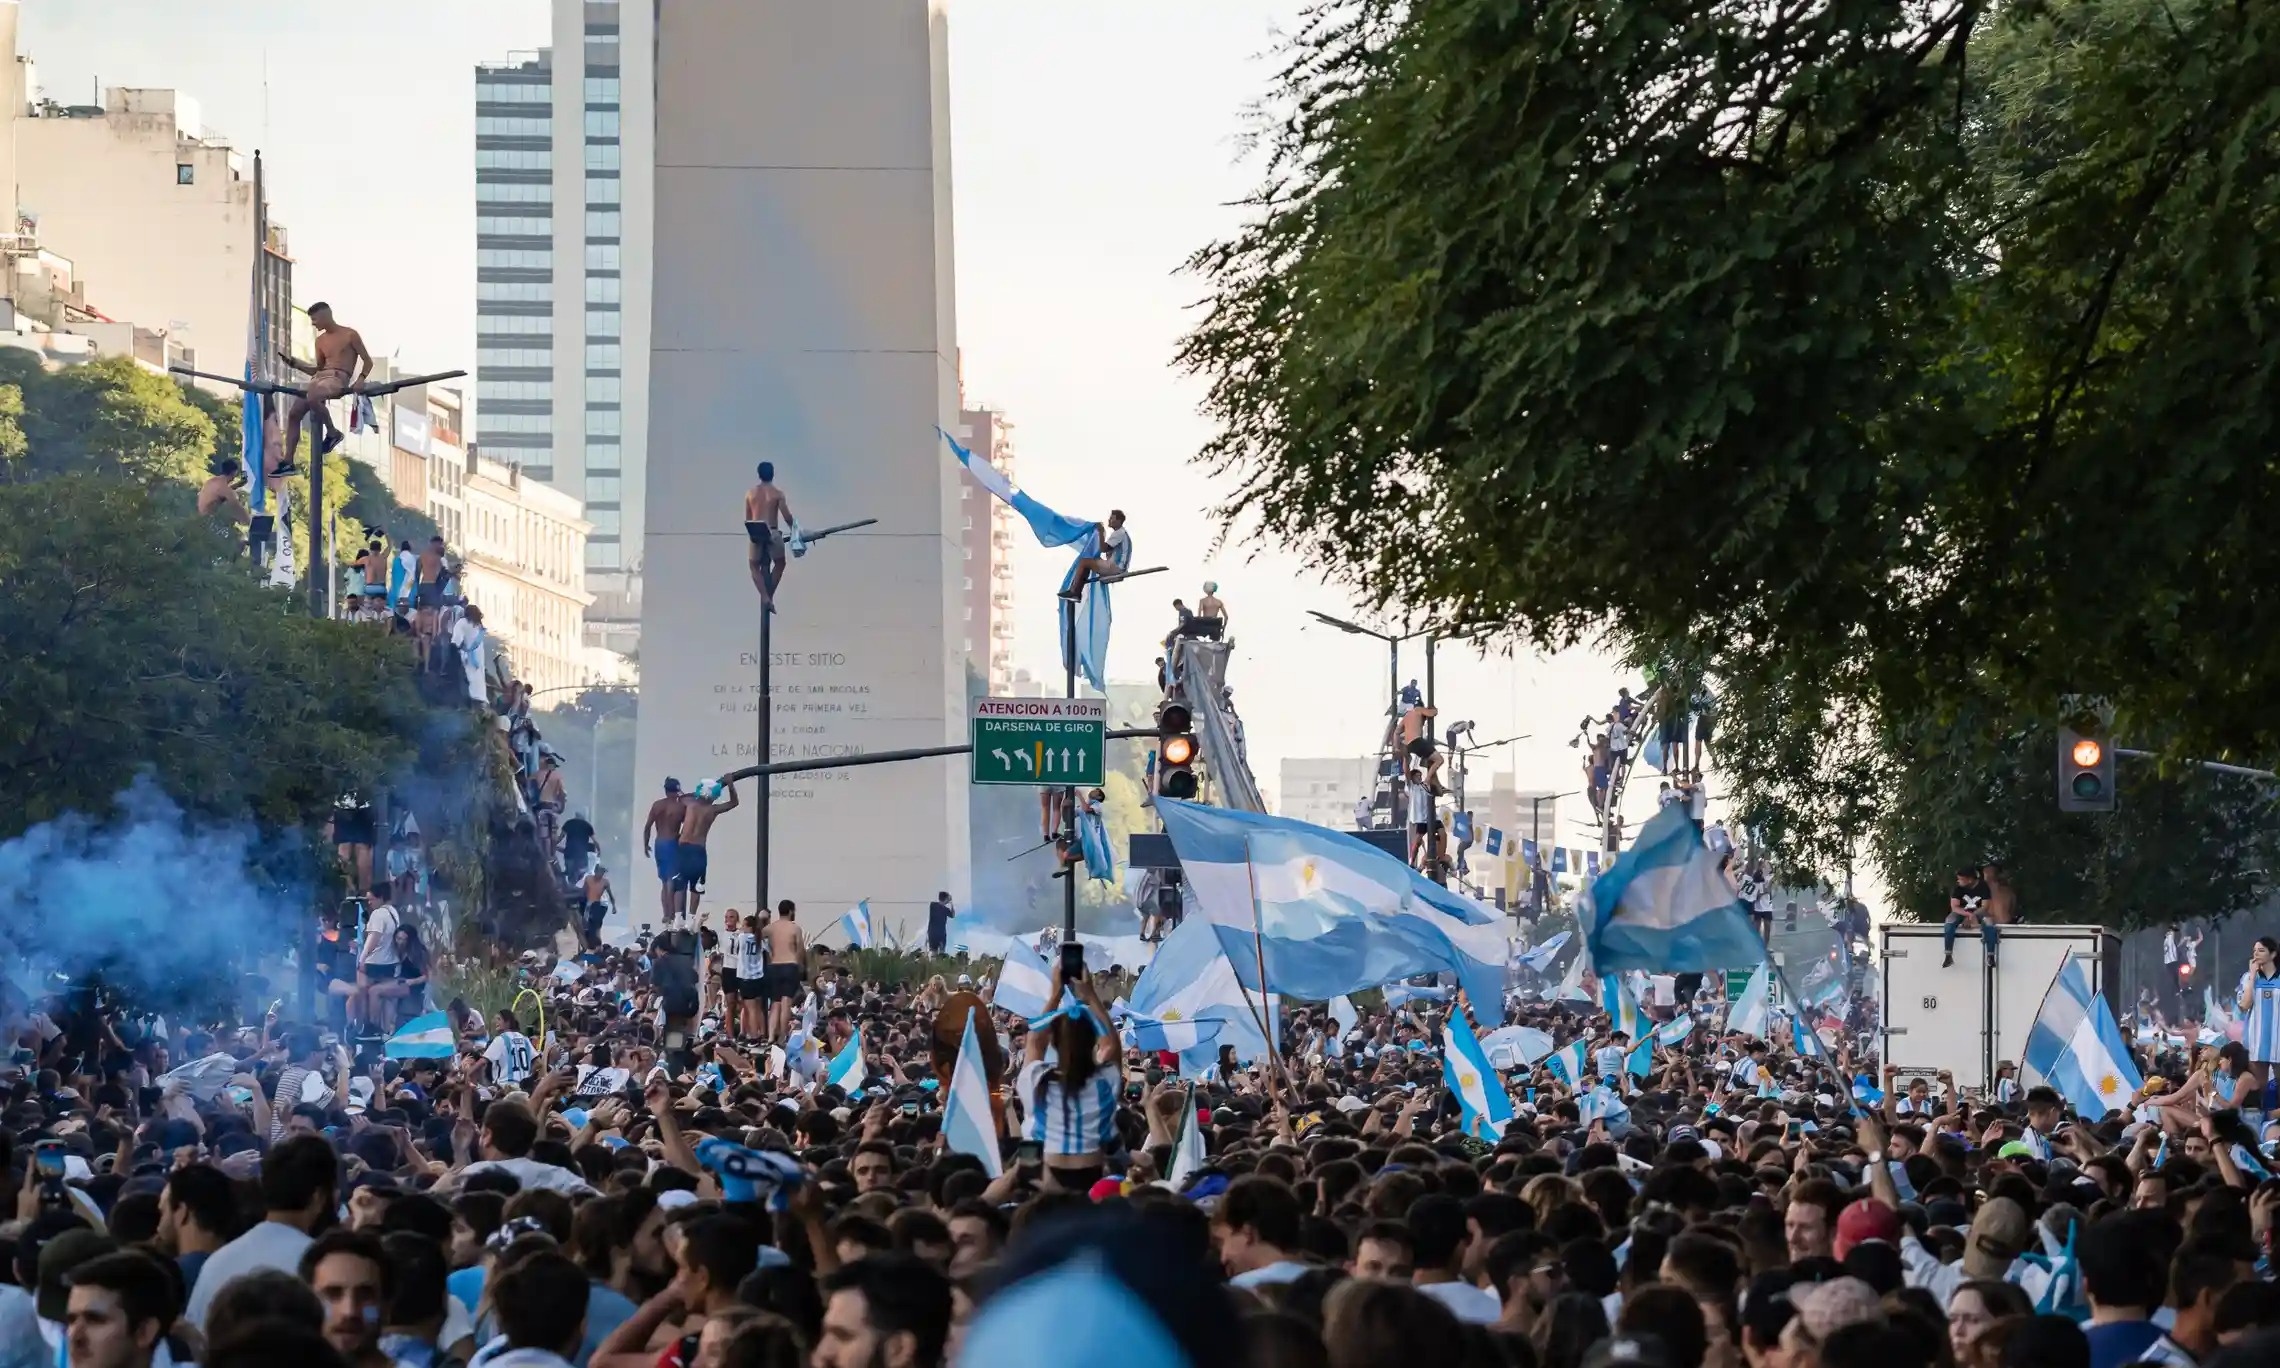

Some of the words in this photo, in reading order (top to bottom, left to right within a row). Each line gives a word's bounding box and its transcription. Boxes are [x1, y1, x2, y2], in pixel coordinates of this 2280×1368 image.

[739, 652, 758, 666] EN
[808, 652, 846, 666] SITIO
[749, 684, 783, 694] TORE
[788, 684, 801, 694] DE
[829, 684, 871, 694] NICOLAS
[776, 703, 797, 713] POR
[802, 703, 842, 713] PRIMERA
[978, 702, 1049, 716] ATENCION
[1052, 704, 1062, 716] A
[1065, 704, 1088, 716] 100
[1090, 706, 1102, 717] m
[985, 721, 1042, 732] DARSENA
[1046, 722, 1061, 732] DE
[1064, 723, 1094, 733] GIRO
[711, 743, 728, 757] LA
[736, 742, 795, 757] BANERA
[745, 940, 757, 956] 10
[1923, 997, 1937, 1009] 80
[511, 1046, 529, 1072] 10
